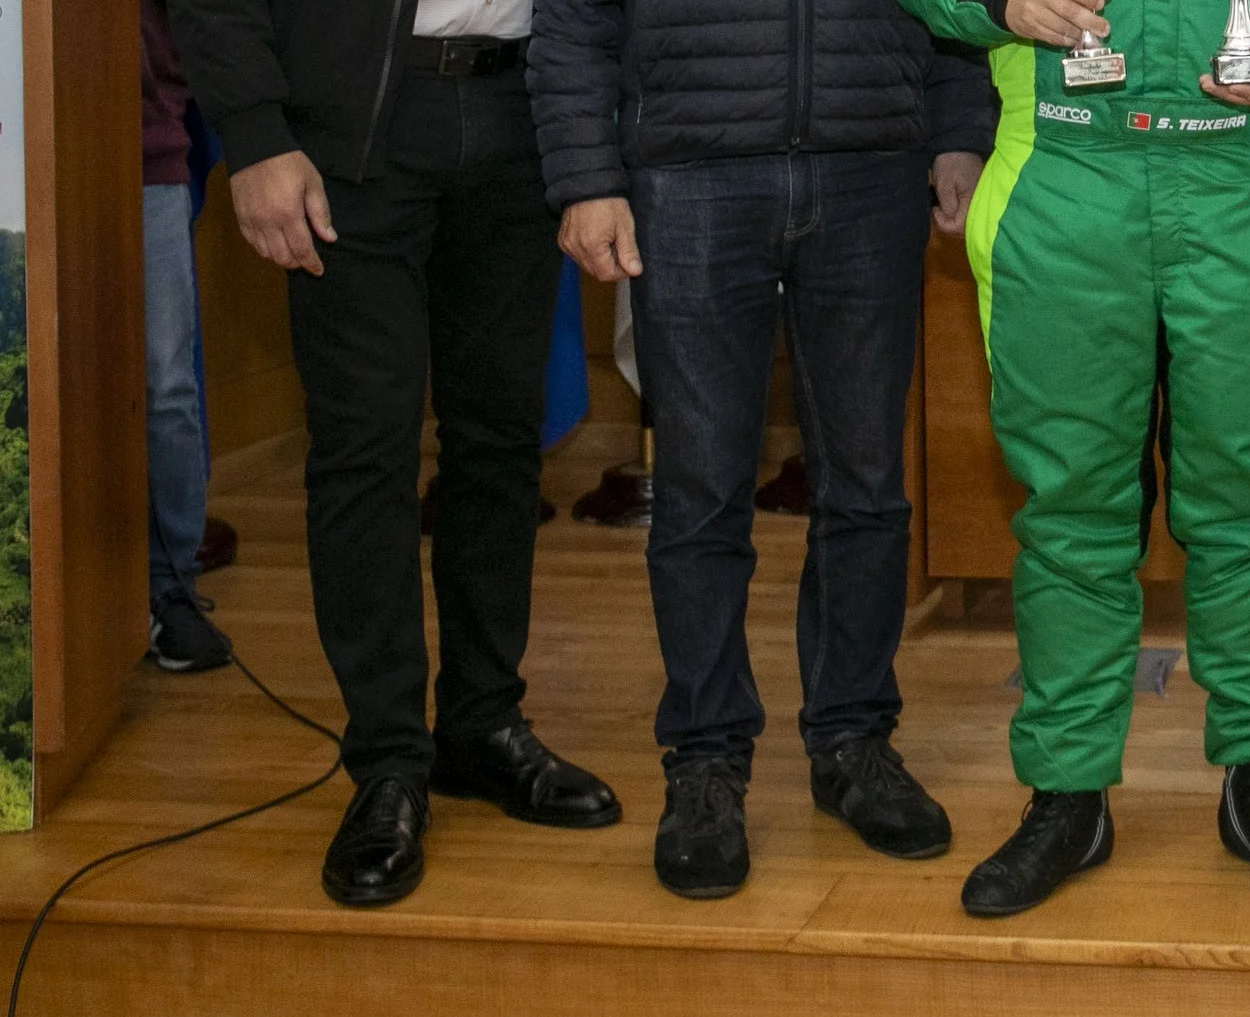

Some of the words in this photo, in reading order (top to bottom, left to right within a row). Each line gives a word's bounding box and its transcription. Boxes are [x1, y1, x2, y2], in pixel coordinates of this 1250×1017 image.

[1037, 102, 1092, 124] sparco
[1156, 118, 1174, 129] S.
[1179, 115, 1247, 130] TEIXEIRA
